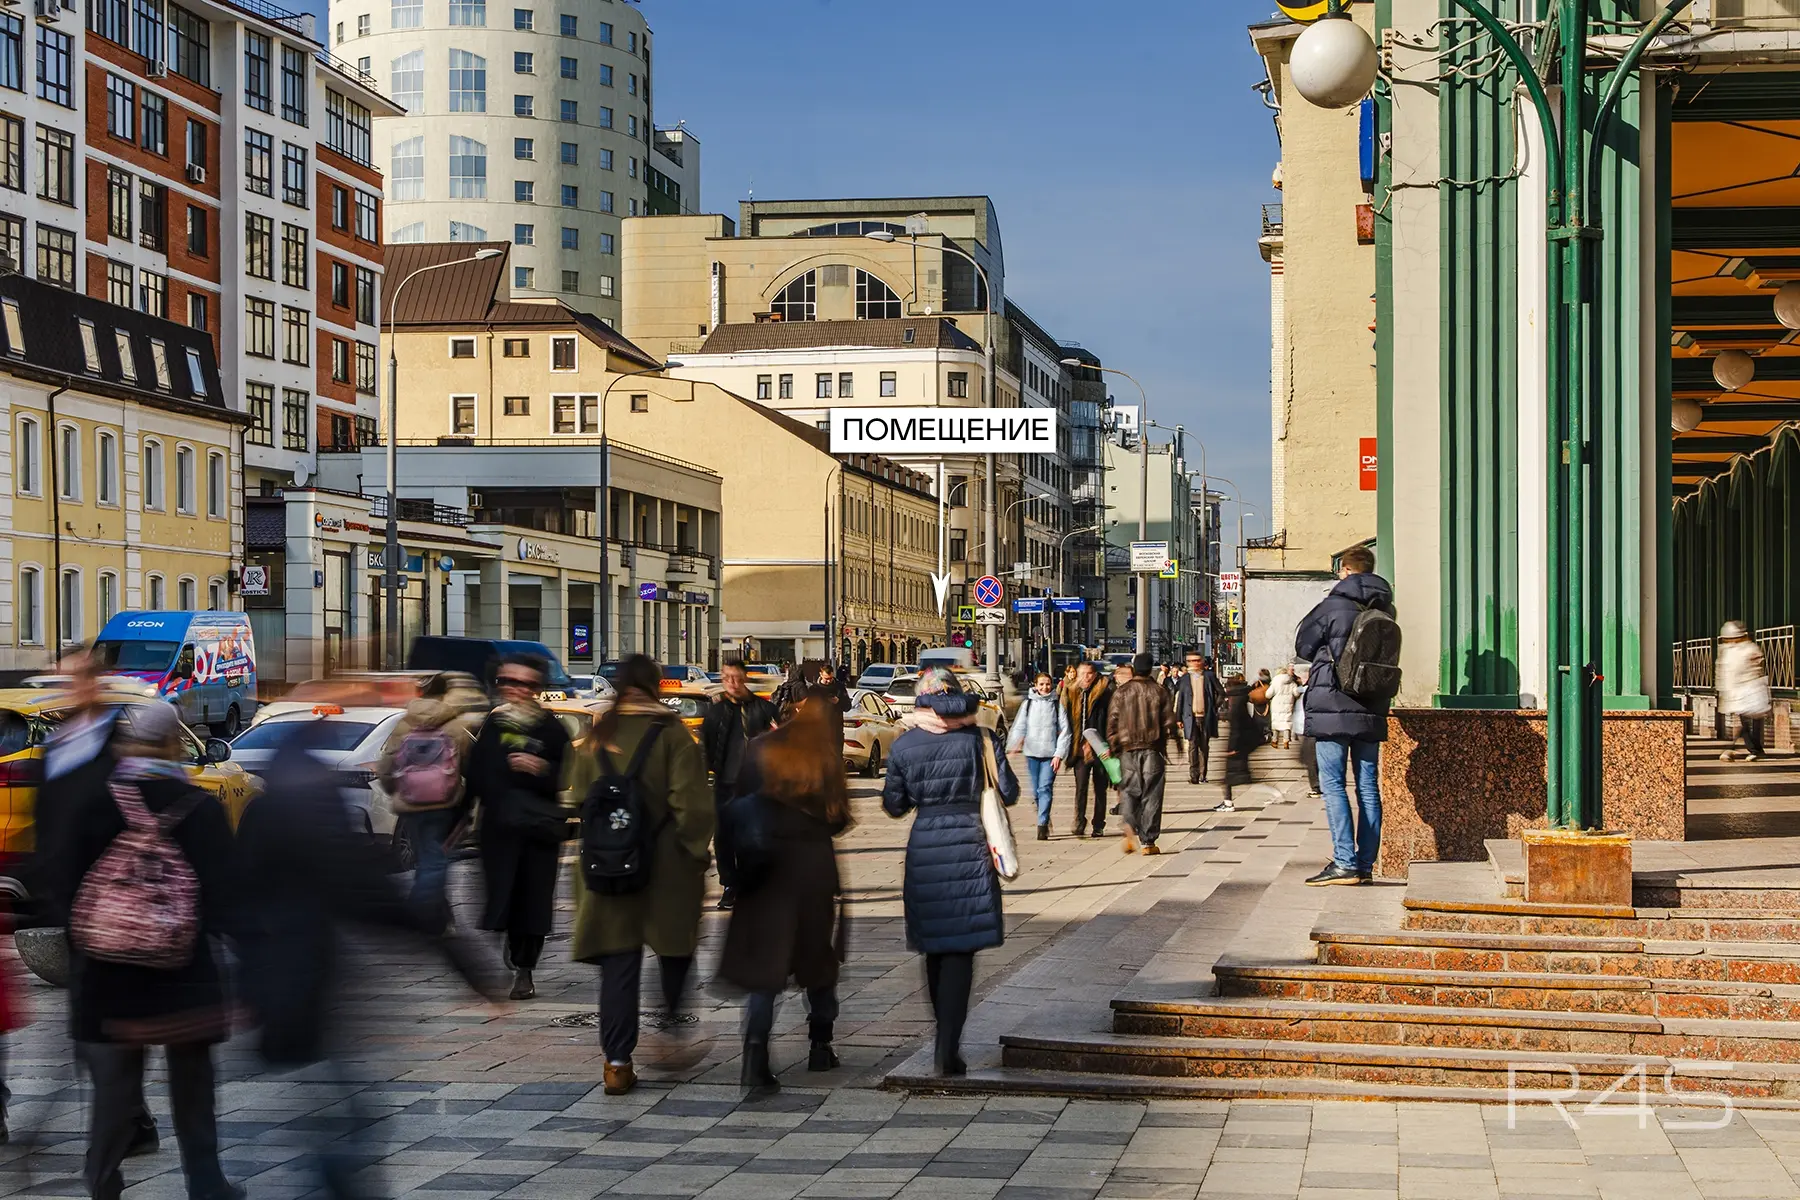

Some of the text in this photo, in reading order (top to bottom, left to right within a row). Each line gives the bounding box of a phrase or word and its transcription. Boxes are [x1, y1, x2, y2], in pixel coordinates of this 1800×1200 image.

[1362, 455, 1377, 464] DN
[527, 542, 541, 559] БКС
[1222, 582, 1238, 590] 24/7
